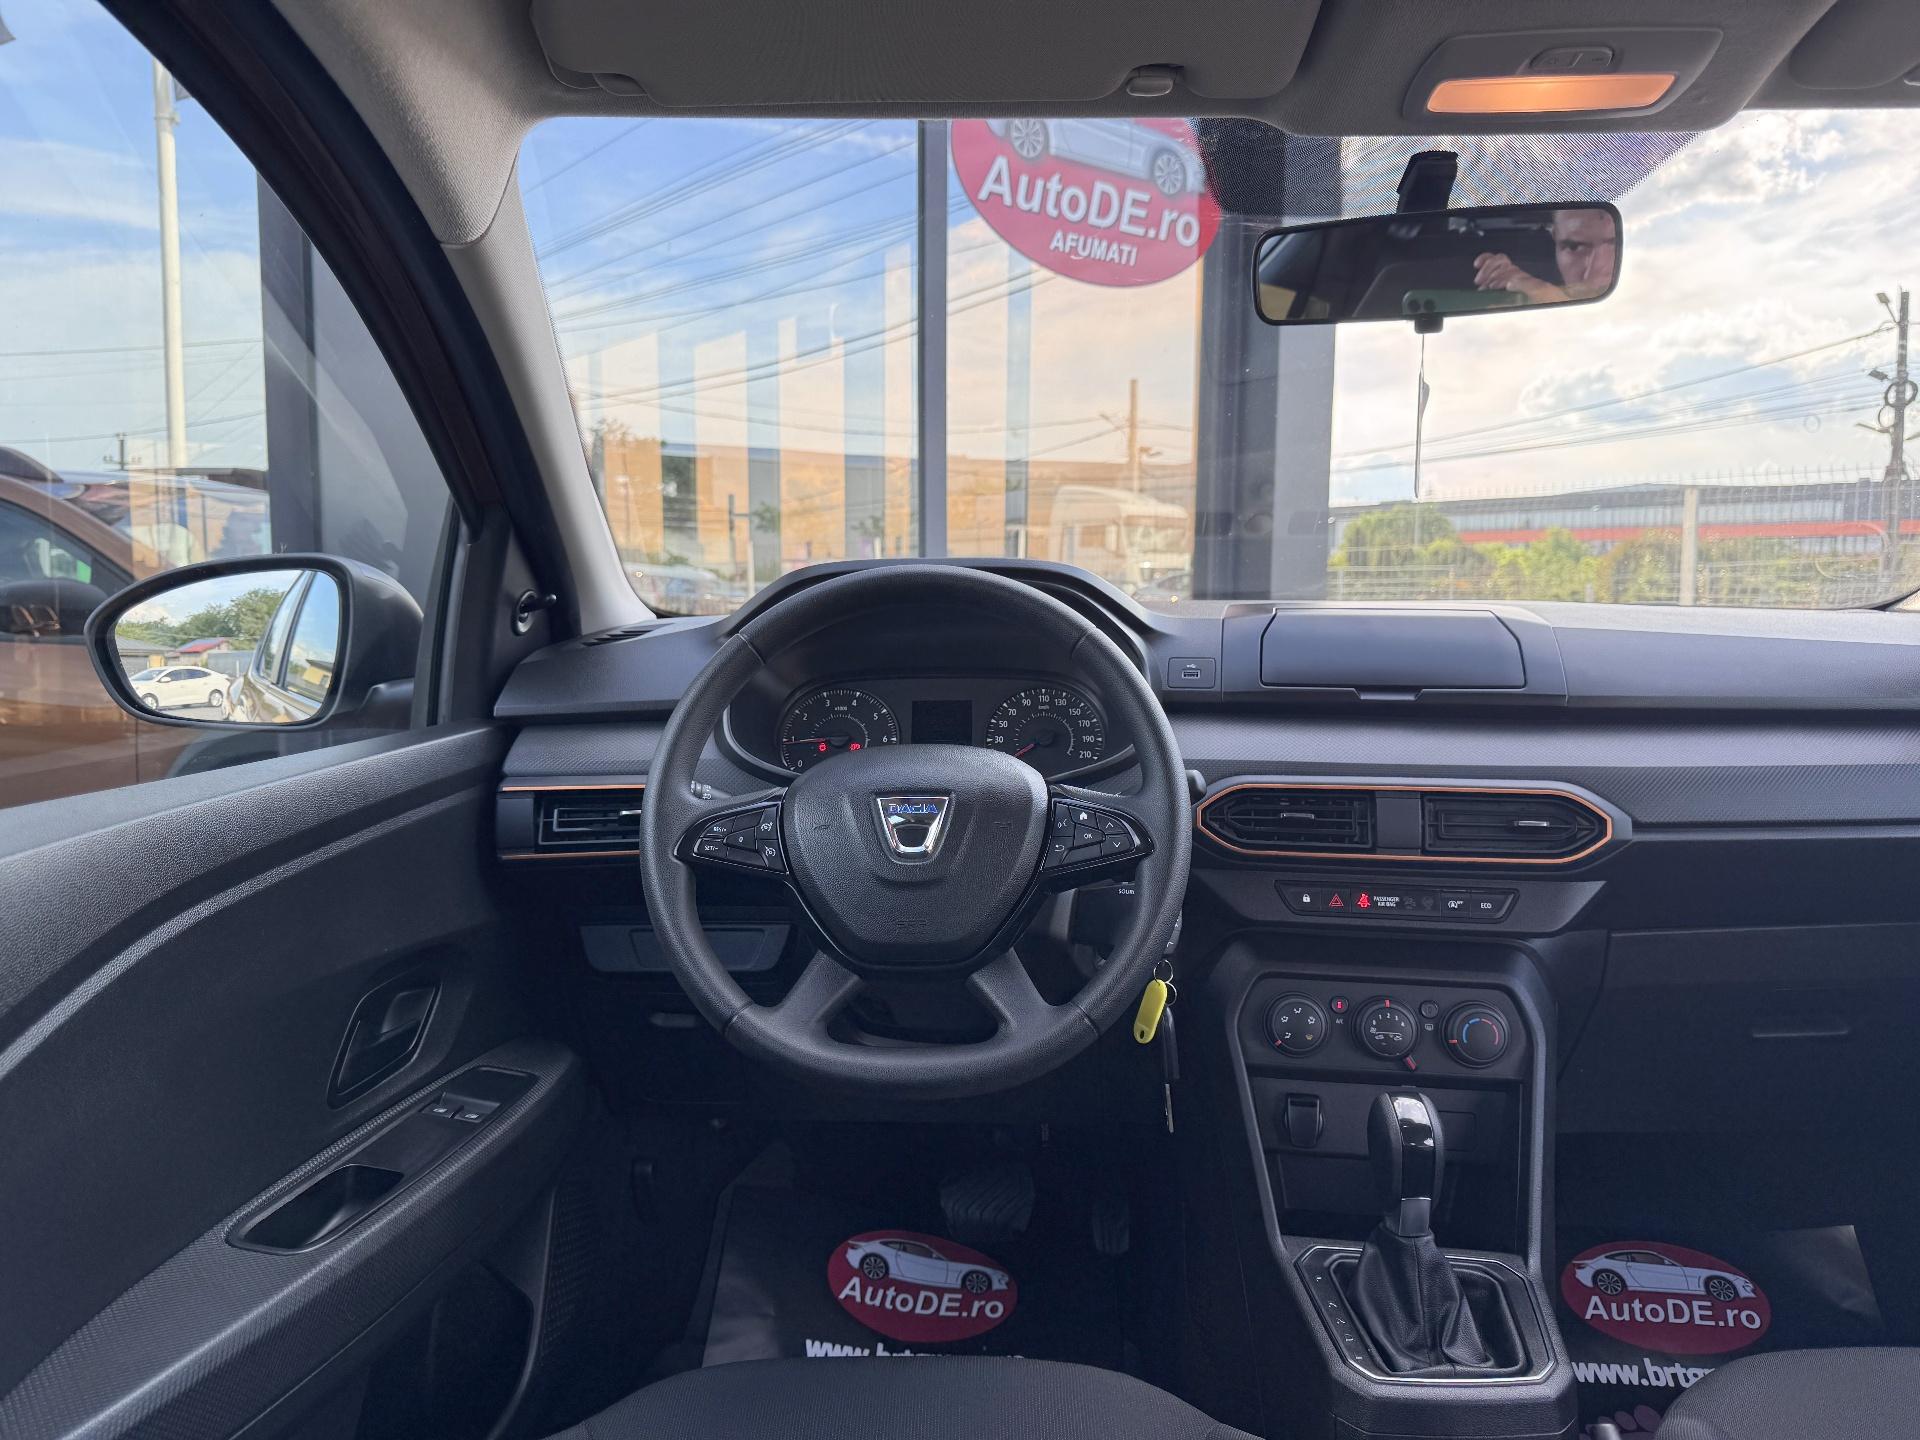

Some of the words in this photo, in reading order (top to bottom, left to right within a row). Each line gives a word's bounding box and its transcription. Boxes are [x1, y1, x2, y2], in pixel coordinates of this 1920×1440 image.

[977, 155, 1200, 248] AutoDE.ro
[1048, 230, 1138, 267] AFUMATI
[1022, 699, 1031, 707] 90
[1039, 695, 1050, 703] 110
[1008, 708, 1017, 716] 70
[1069, 708, 1081, 716] 150
[802, 713, 808, 721] 2
[999, 720, 1008, 728] 50
[1079, 720, 1090, 728] 170
[882, 735, 888, 743] 6
[994, 735, 1004, 744] 30
[1083, 735, 1095, 743] 190
[1079, 750, 1092, 759] 210
[797, 759, 803, 768] 0
[888, 803, 939, 814] DACIA
[838, 1275, 1004, 1319] AutoDE.ro
[1584, 1294, 1762, 1330] AutoDE.ro
[1571, 1357, 1716, 1389] www.brt
